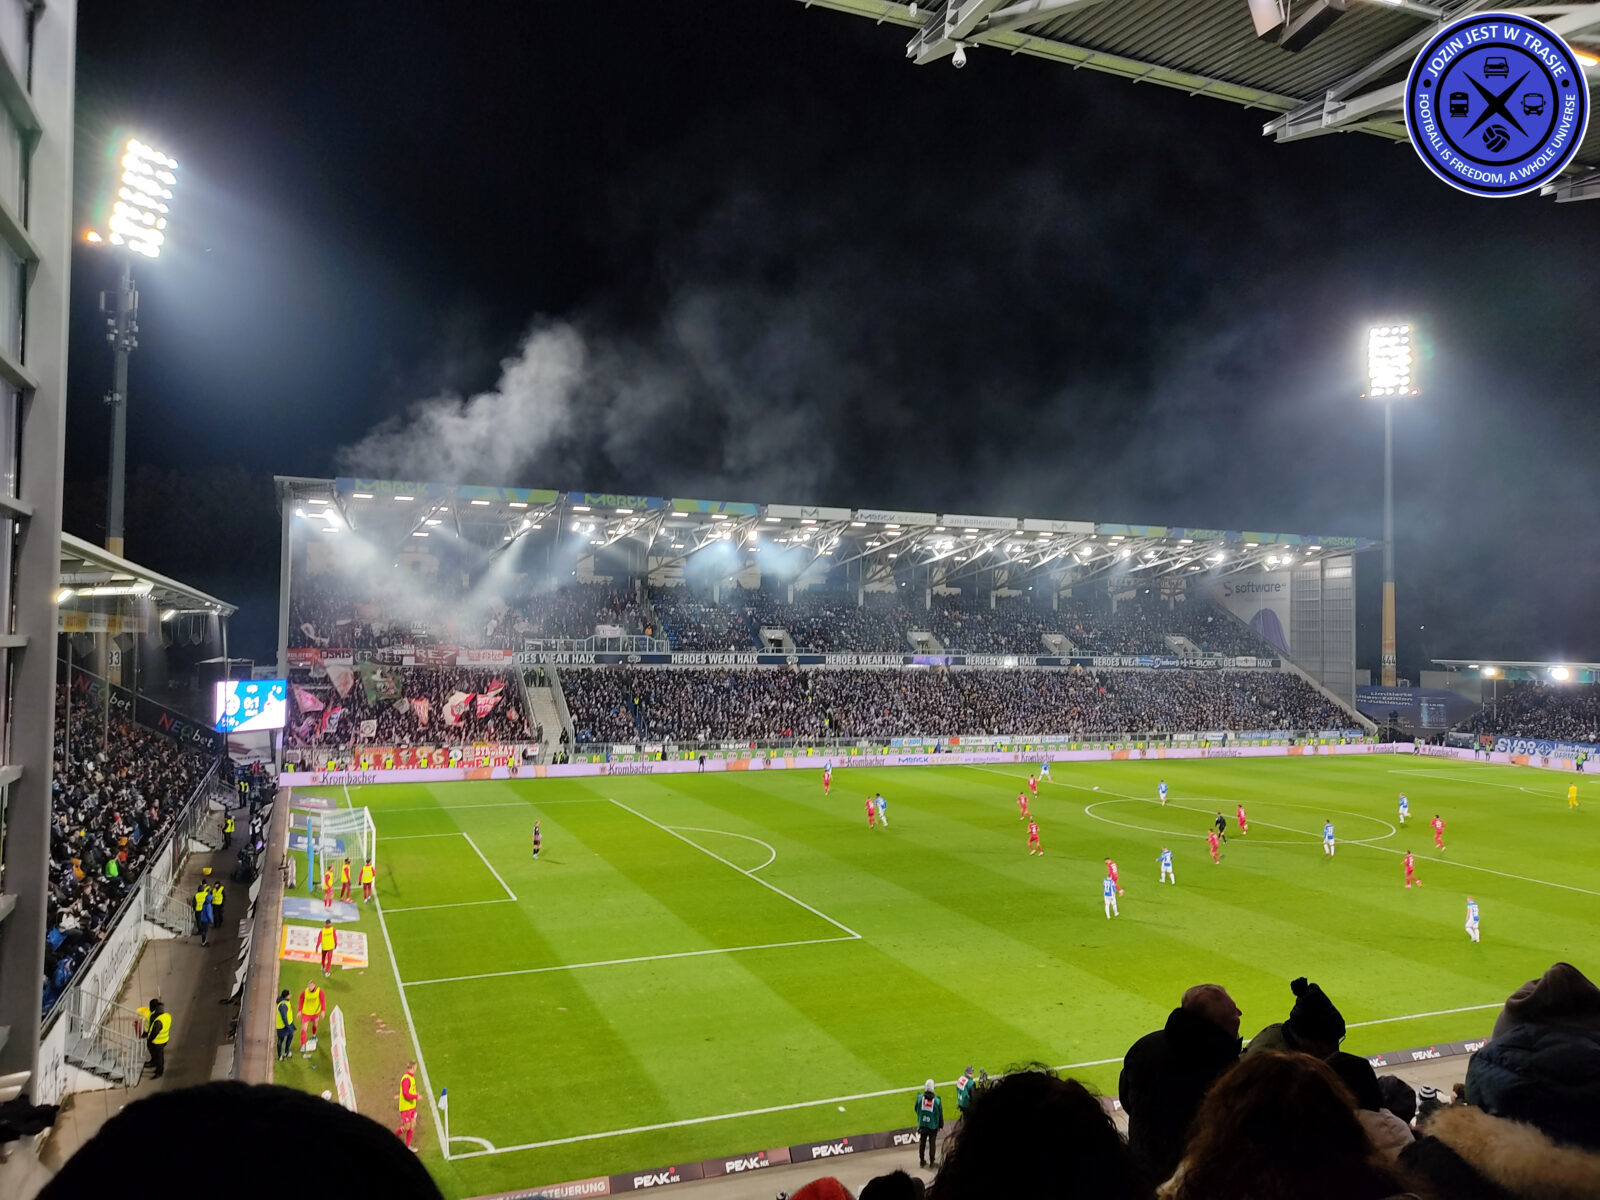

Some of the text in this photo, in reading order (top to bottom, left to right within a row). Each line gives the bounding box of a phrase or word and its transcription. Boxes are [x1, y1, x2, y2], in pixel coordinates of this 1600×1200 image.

[1235, 581, 1281, 594] software
[572, 654, 596, 664] HAIX
[671, 654, 758, 664] HEROES WEAR HAIX
[825, 655, 904, 665] HEROES WEAR HAIX
[965, 656, 995, 666] HEROES
[1019, 656, 1037, 666] HAIX
[1093, 657, 1119, 667] HEROES
[608, 763, 654, 775] Krombacher
[320, 772, 377, 785] Krombacher
[1412, 1049, 1434, 1061] PEAK
[812, 1142, 845, 1159] PEAK
[725, 1156, 760, 1174] PEAK
[634, 1172, 671, 1189] PEAK
[542, 1181, 605, 1198] STEUERUNG
